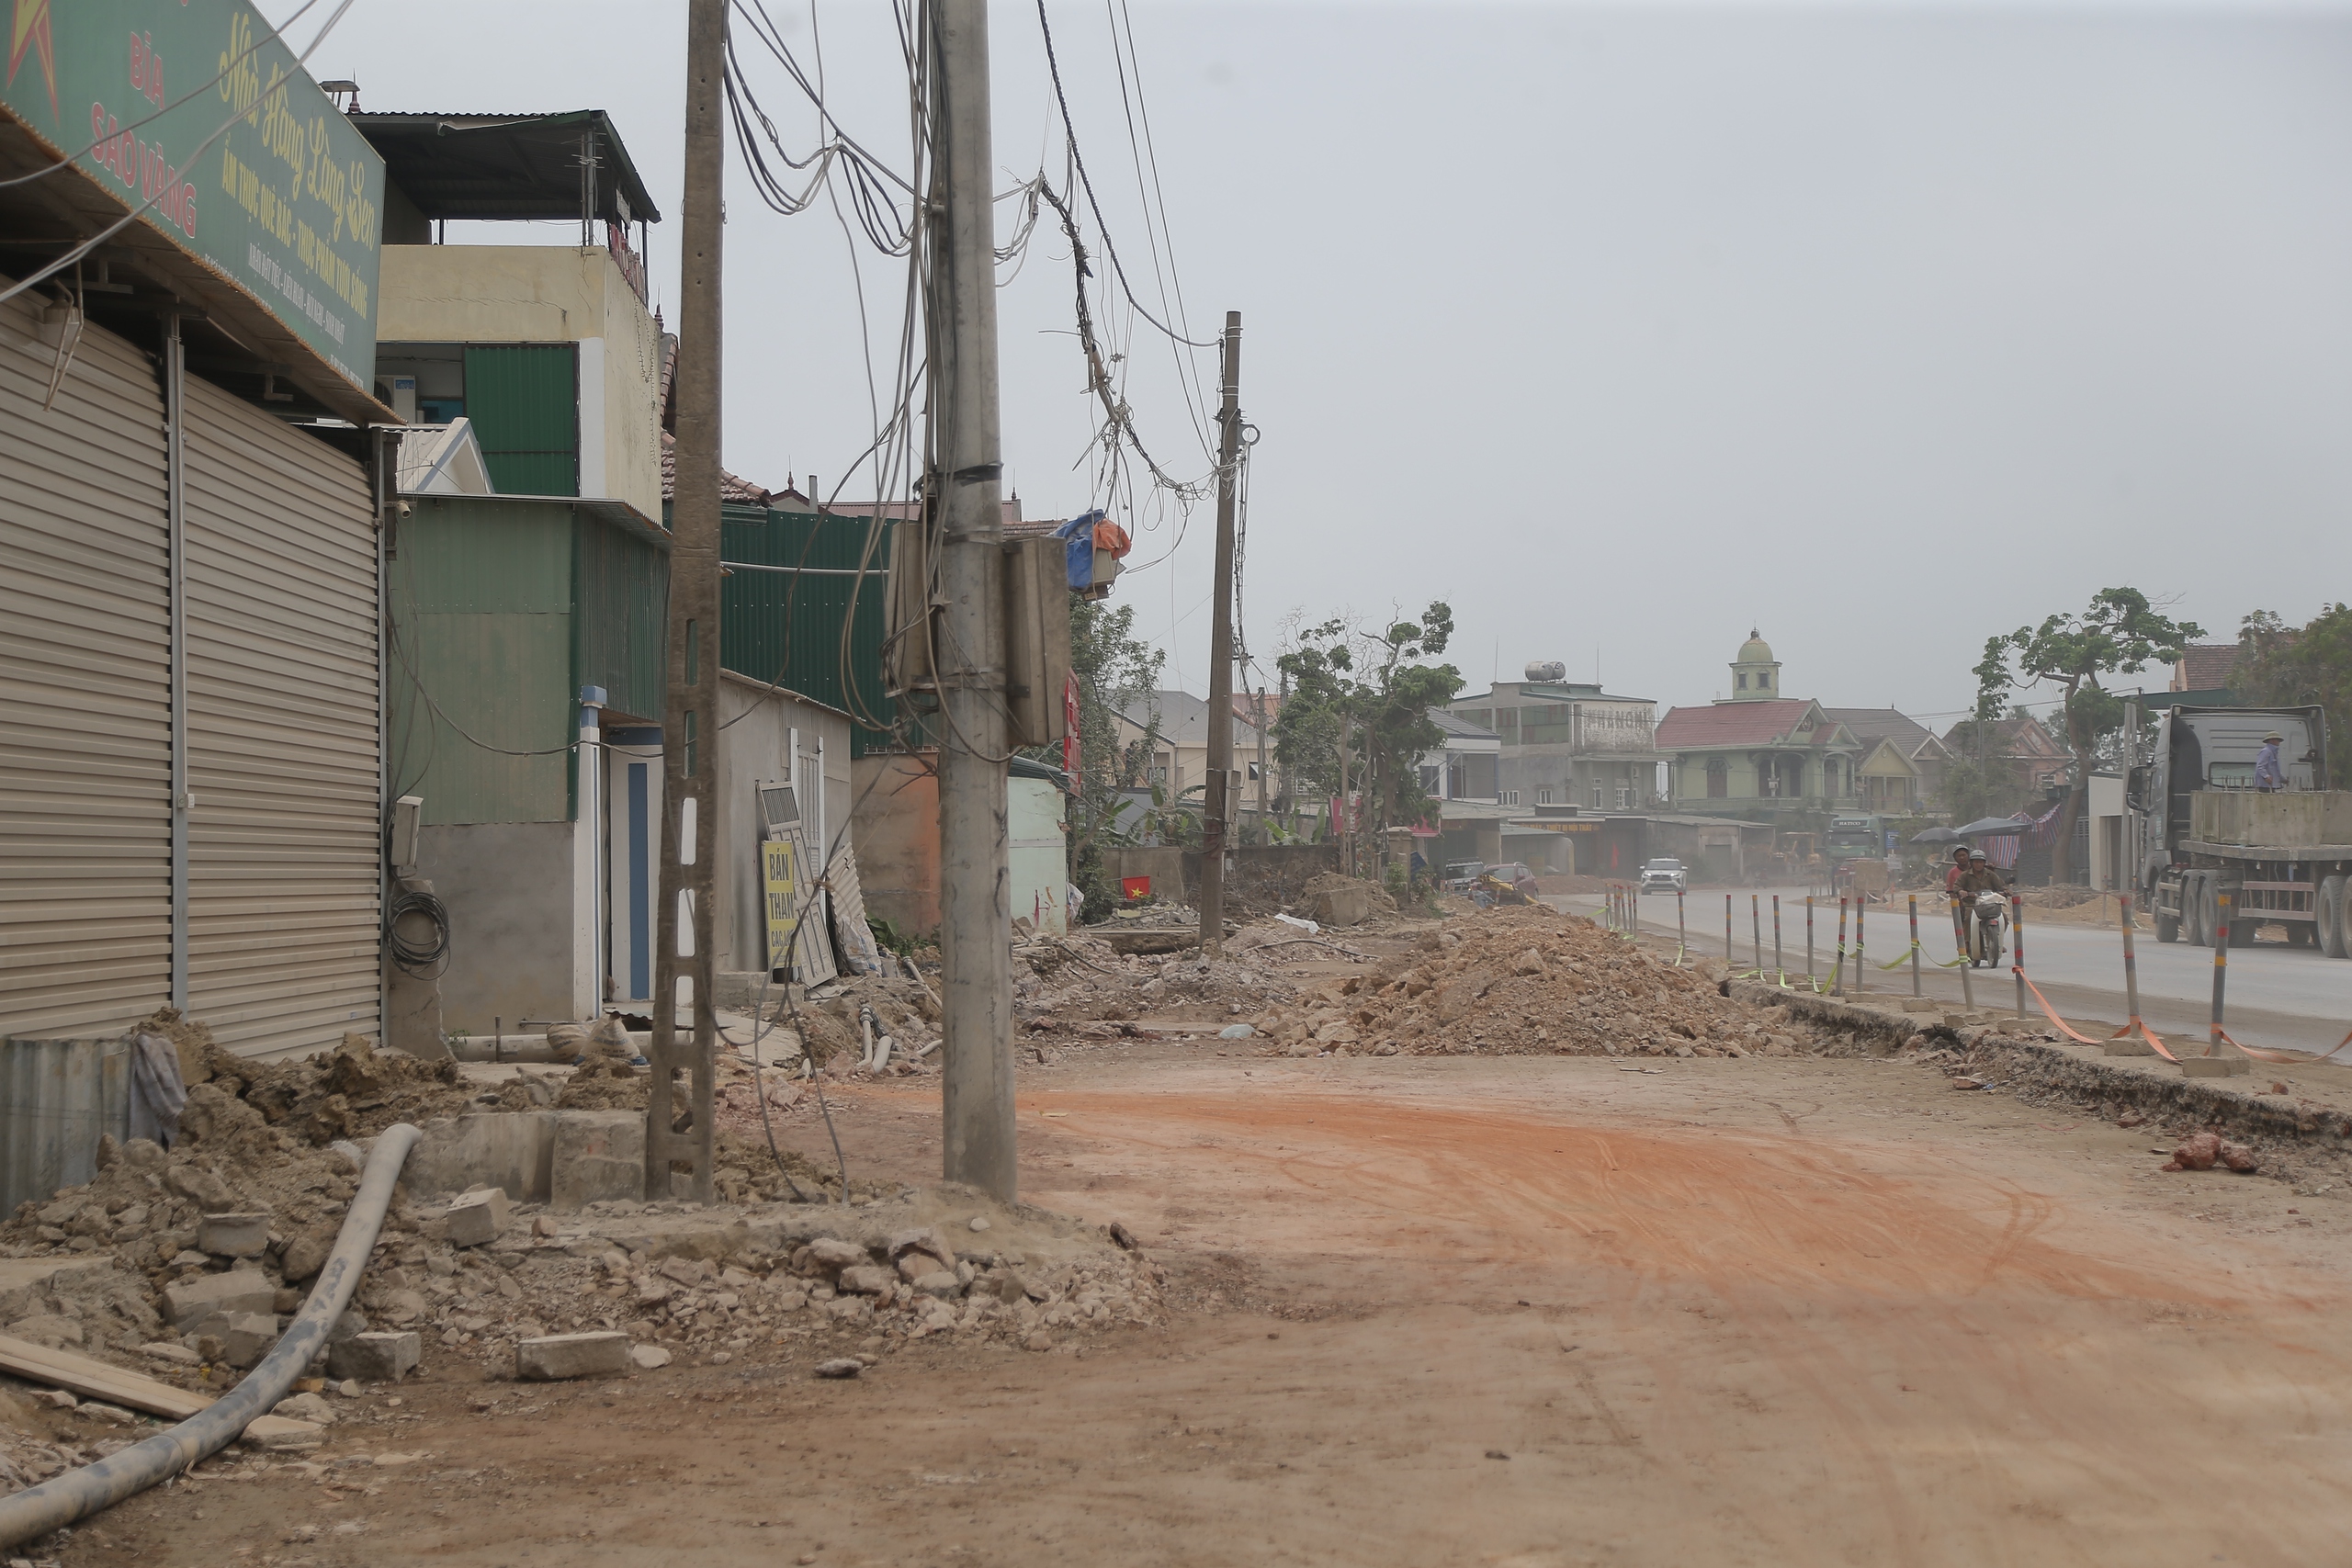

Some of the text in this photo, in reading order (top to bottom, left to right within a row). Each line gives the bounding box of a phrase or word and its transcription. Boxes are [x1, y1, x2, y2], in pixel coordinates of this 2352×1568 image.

[91, 101, 196, 240] SAO VÀNG
[219, 12, 376, 252] Nhà Hàng Làng Sen
[239, 162, 259, 223] THỰC
[260, 184, 276, 234] QUÊ
[277, 196, 292, 249] BÁC
[298, 219, 315, 275] THỰC
[316, 231, 335, 290] PHẨM
[351, 265, 368, 321] SỐNG
[768, 847, 790, 882] BÁN
[768, 892, 795, 920] THAN
